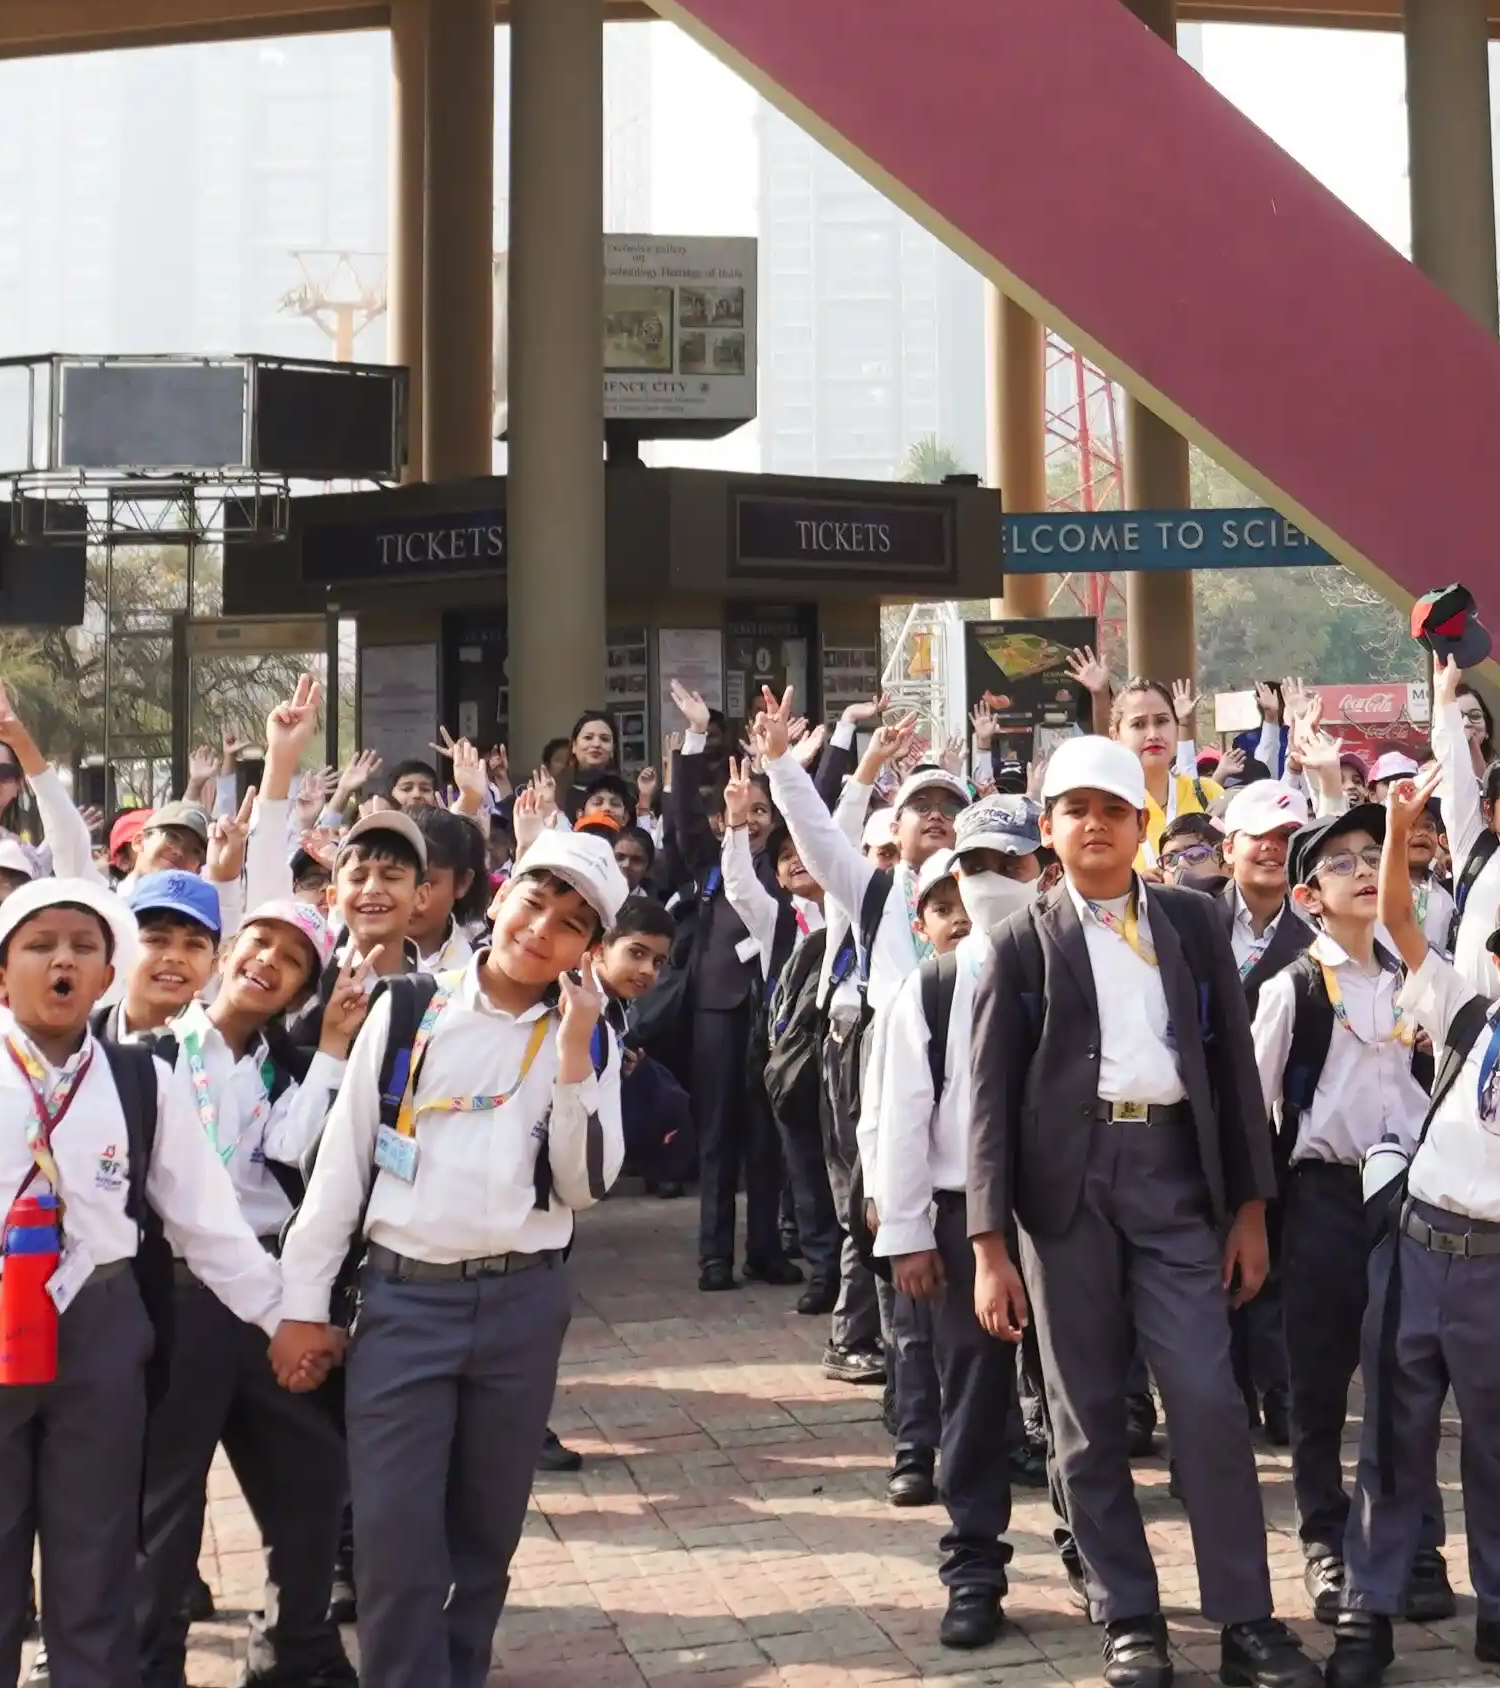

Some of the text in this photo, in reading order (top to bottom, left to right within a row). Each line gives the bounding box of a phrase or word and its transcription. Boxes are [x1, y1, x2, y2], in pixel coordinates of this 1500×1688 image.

[376, 525, 504, 567] TICKETS
[795, 519, 892, 553] TICKETS
[1001, 518, 1311, 555] LCOME TO SCIE
